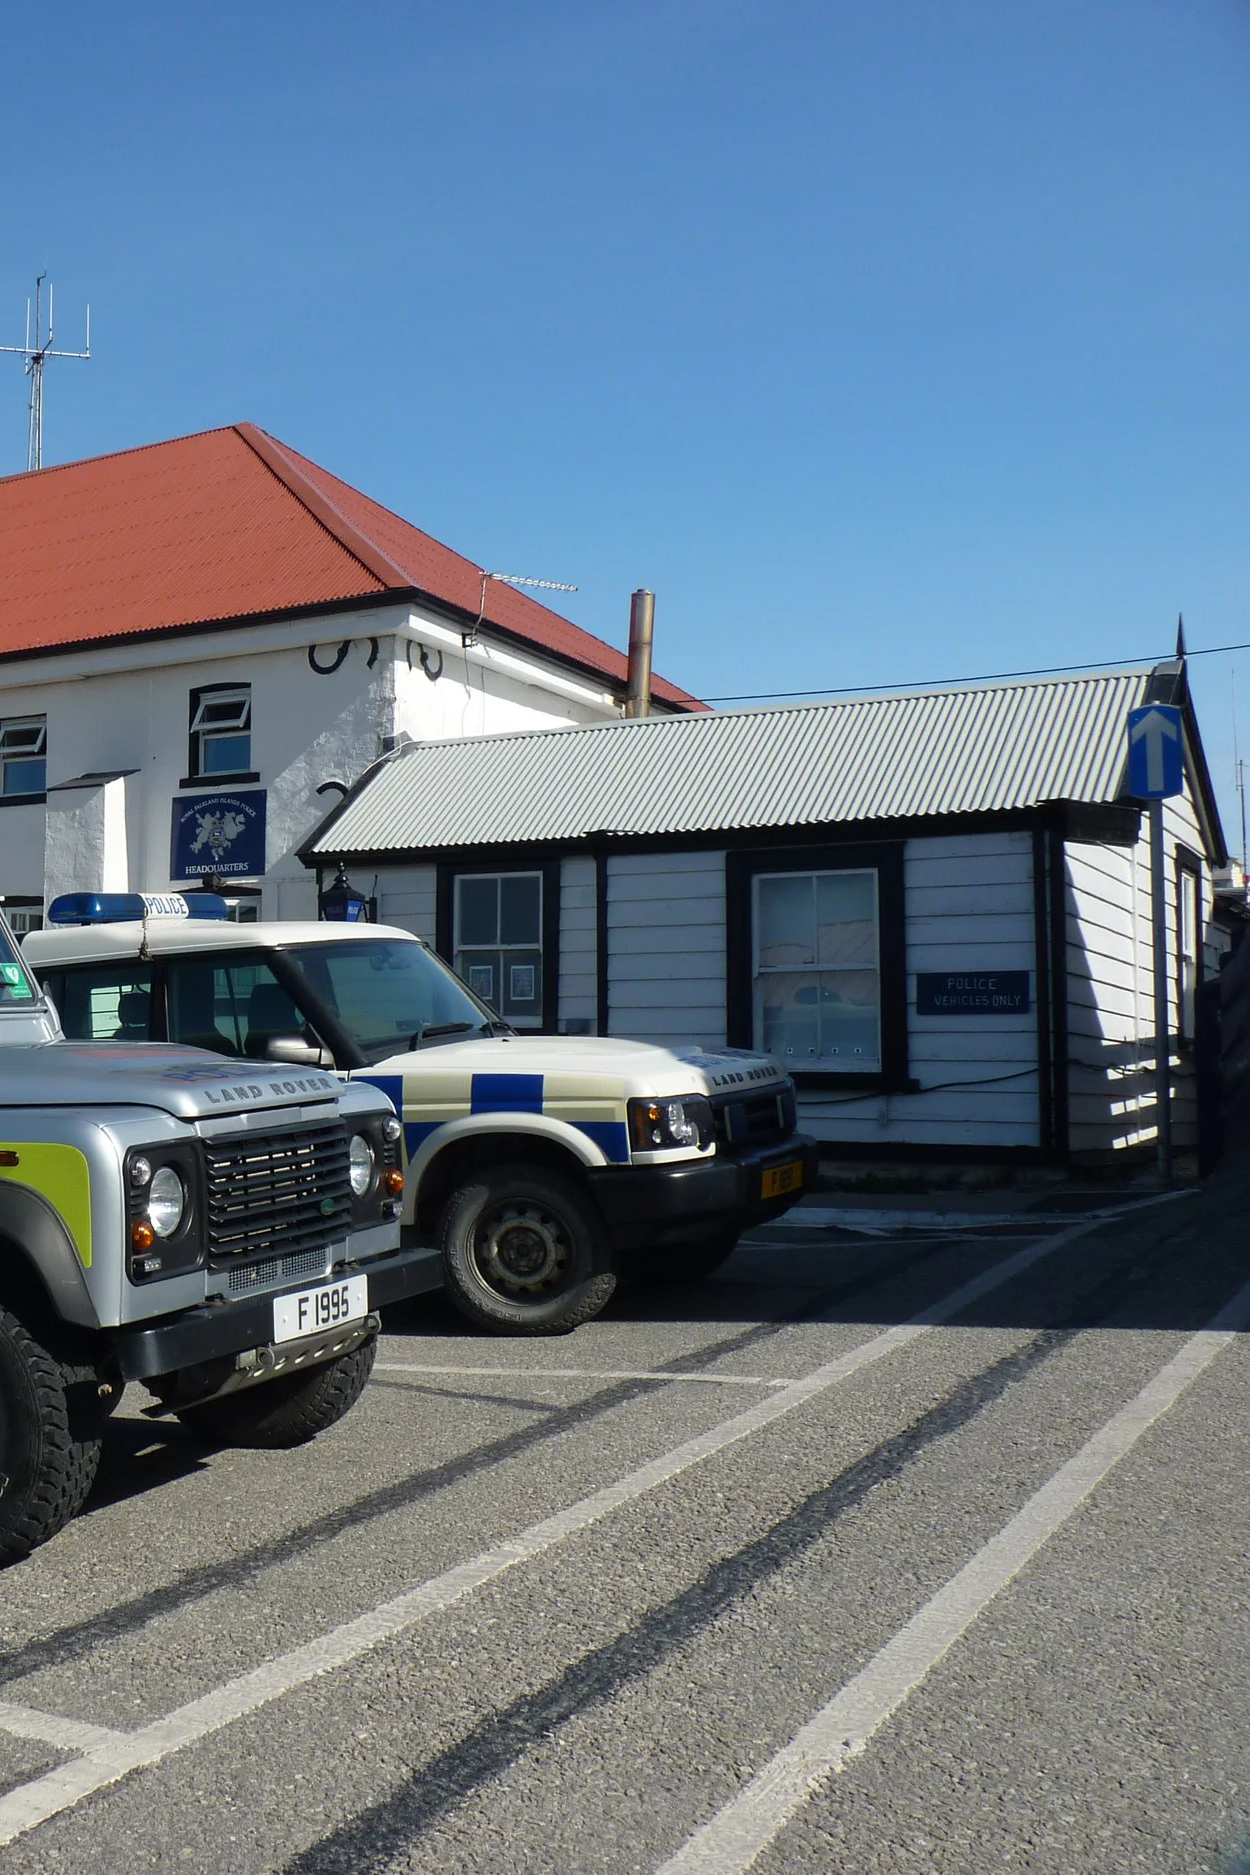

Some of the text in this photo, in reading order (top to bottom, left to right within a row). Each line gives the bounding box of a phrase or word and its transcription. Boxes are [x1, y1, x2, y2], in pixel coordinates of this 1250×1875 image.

[180, 798, 257, 823] ROYAL FALKLAND ISLANDS POLICE
[185, 862, 249, 874] HEADQUARTERS
[149, 897, 187, 915] POLICE
[948, 978, 998, 990] POLICE
[934, 995, 1021, 1006] VEHICLES ONLY
[712, 1065, 778, 1087] LAND ROVER
[204, 1077, 333, 1104] LAND ROVER
[298, 1285, 349, 1331] F 1995
